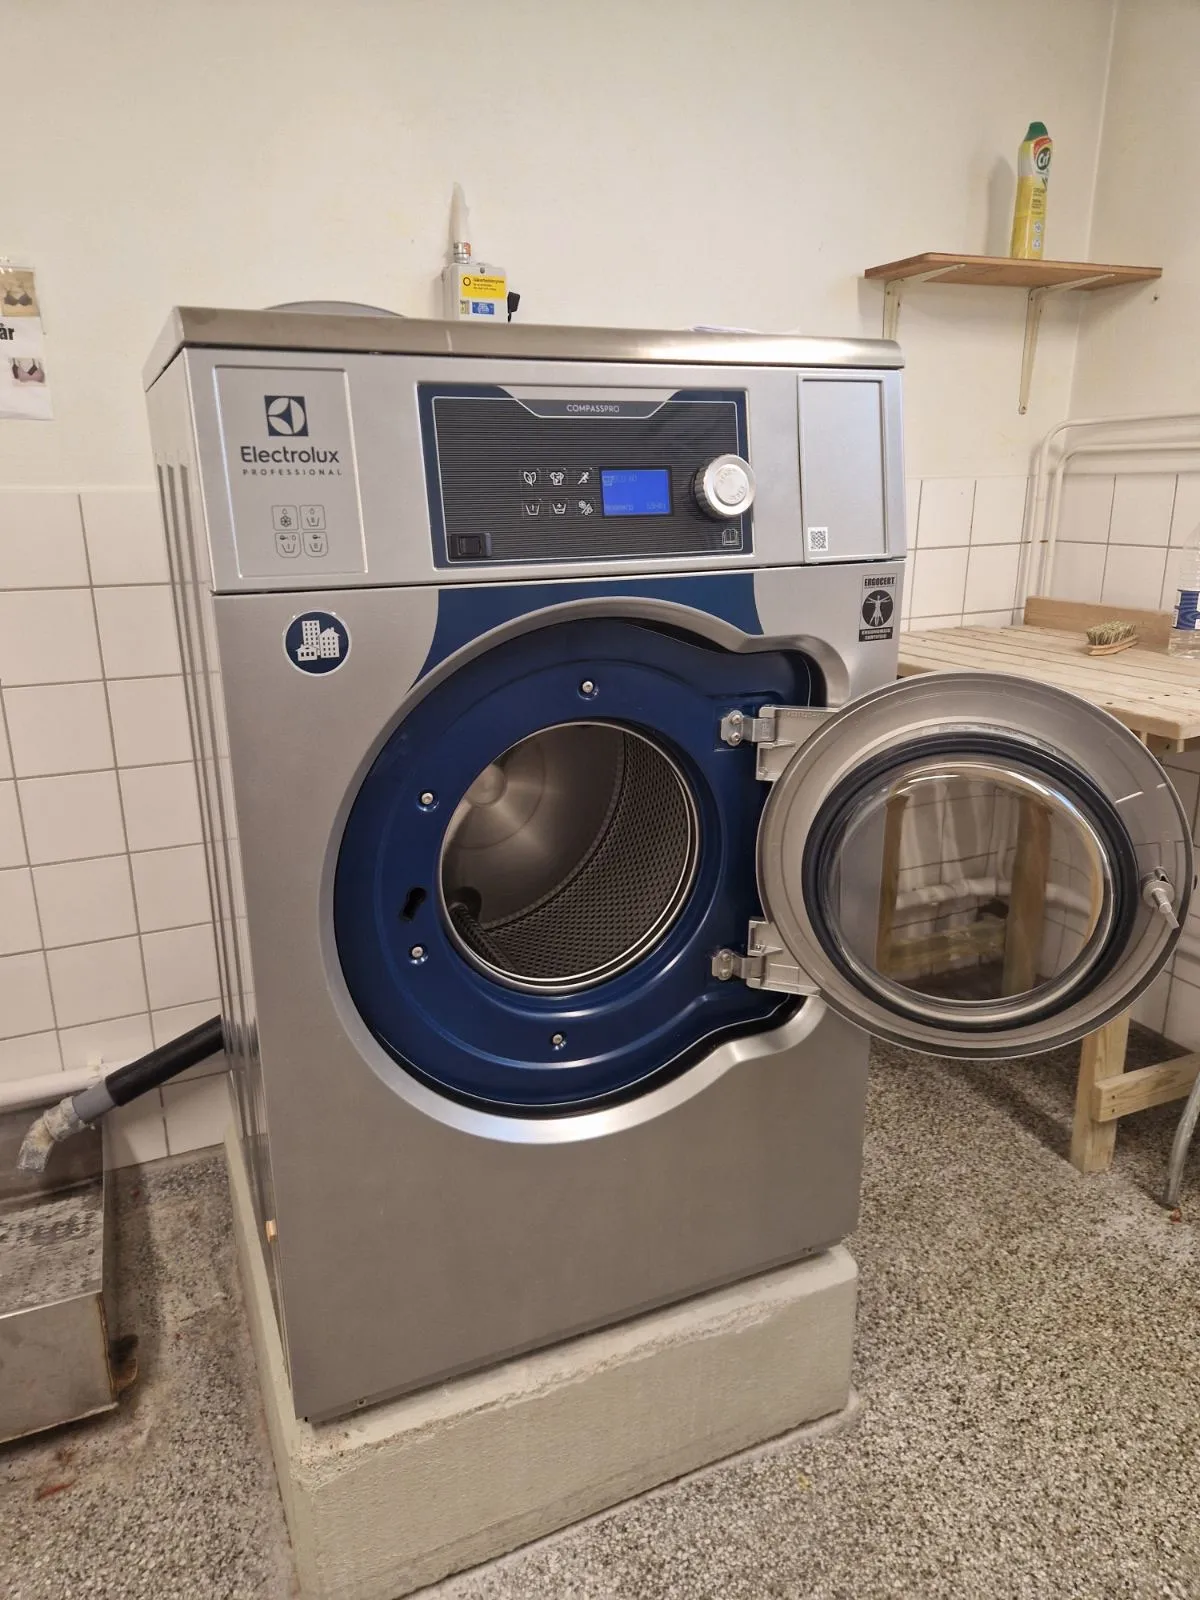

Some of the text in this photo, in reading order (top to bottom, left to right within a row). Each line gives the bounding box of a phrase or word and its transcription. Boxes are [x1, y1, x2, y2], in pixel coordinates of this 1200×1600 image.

[566, 404, 620, 413] COMPASSPRO
[240, 445, 340, 463] Electrolux
[864, 576, 895, 586] ERGOCERT
